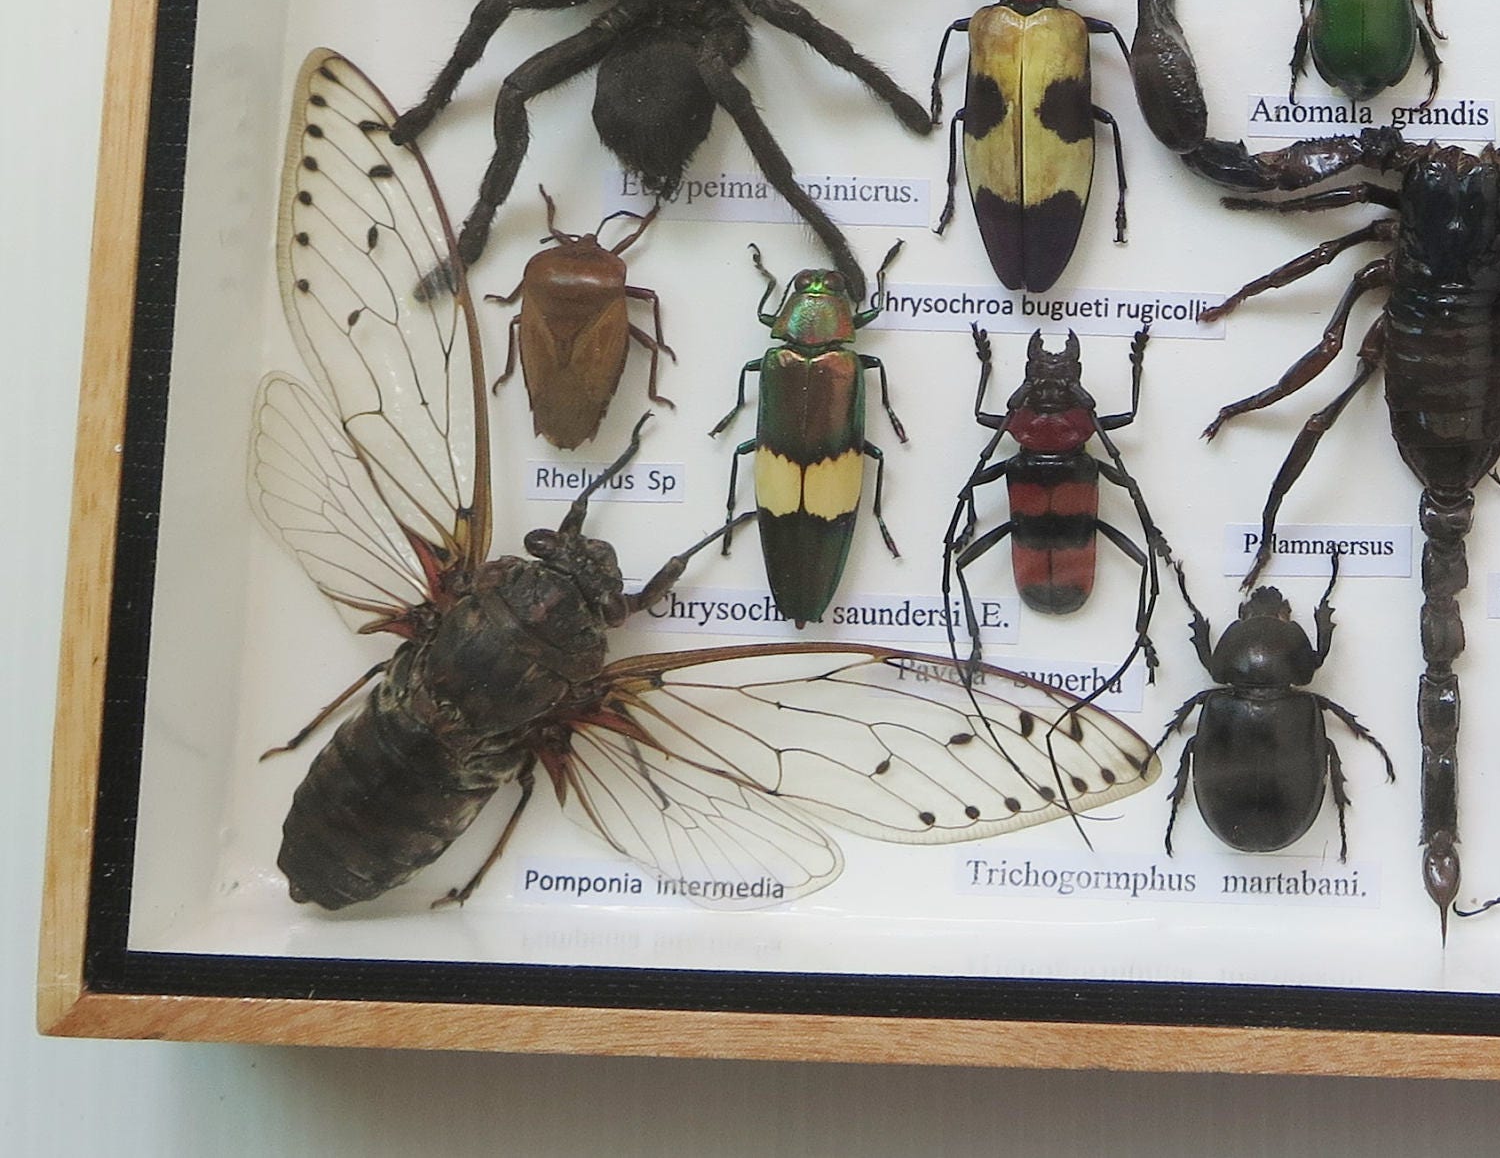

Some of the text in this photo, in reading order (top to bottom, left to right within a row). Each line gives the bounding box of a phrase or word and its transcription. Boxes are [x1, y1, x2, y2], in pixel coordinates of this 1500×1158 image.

[1250, 97, 1489, 129] Anomala grandis
[621, 171, 768, 204] Eypeima
[870, 290, 1218, 324] Chrysochroa bugueti rugicolli
[648, 470, 676, 495] Sp
[1243, 533, 1394, 556] Plamnaersus
[650, 592, 1010, 629] Chrysoch saundersi E.
[525, 869, 785, 900] Pomponia intermedia
[966, 859, 1368, 898] Trichogormphus martabani.
